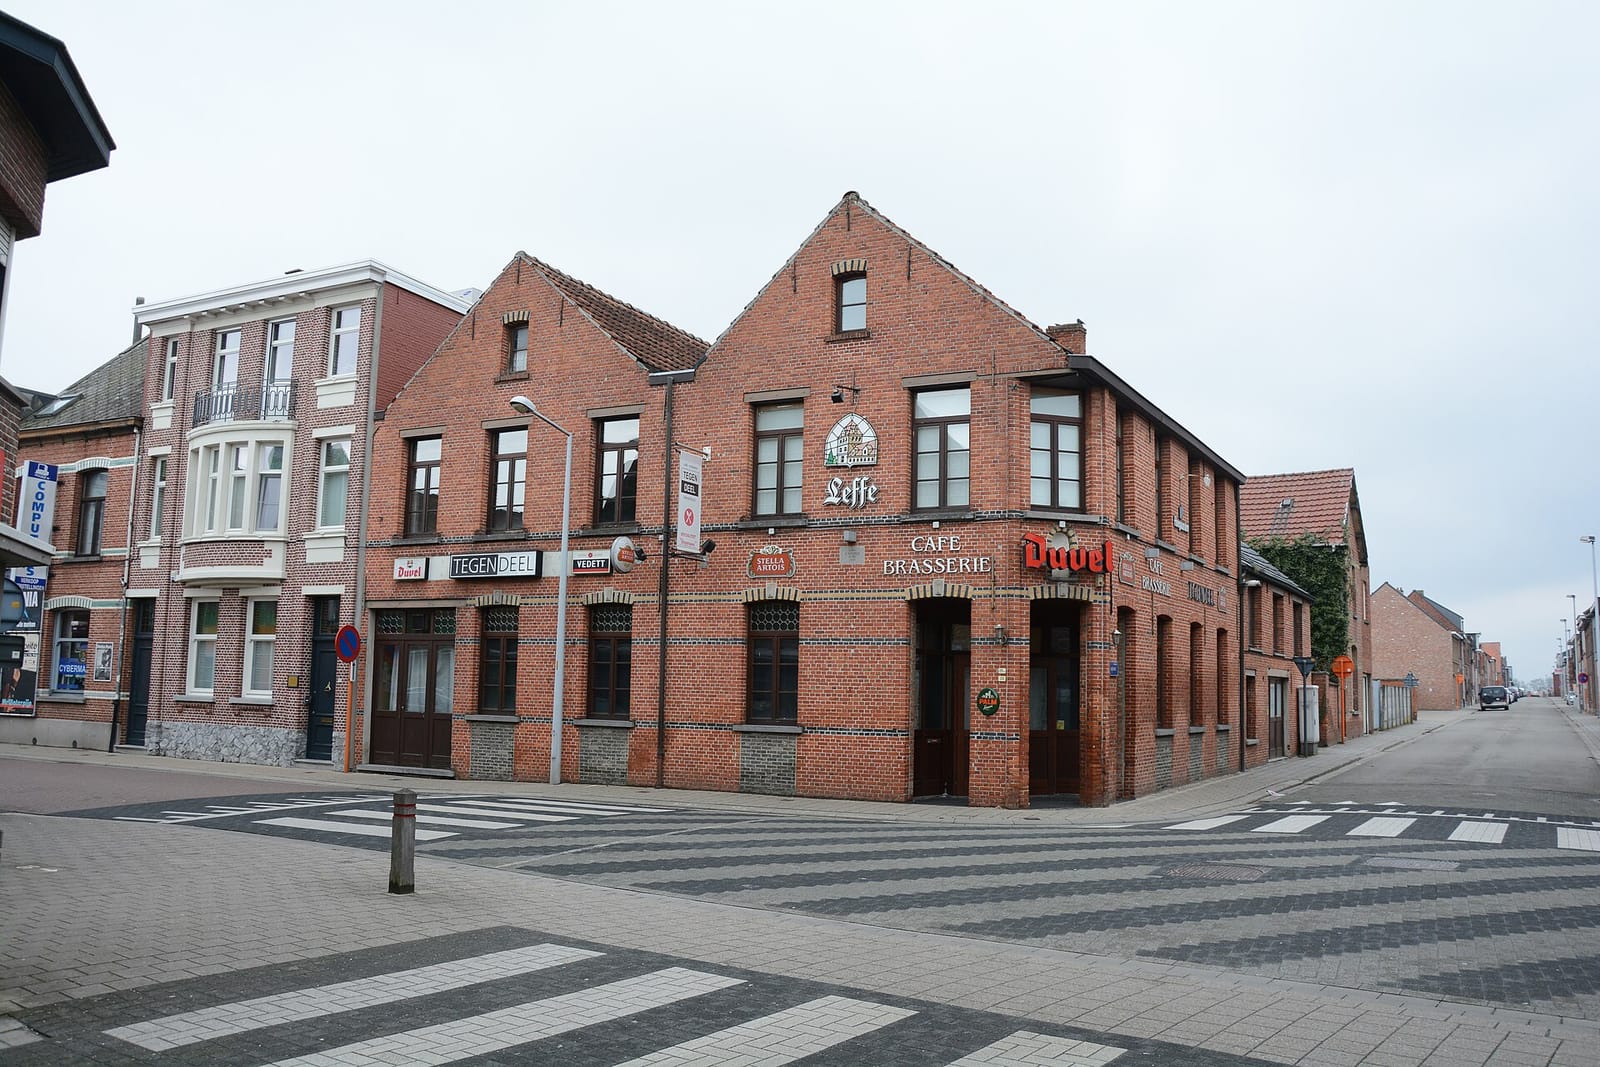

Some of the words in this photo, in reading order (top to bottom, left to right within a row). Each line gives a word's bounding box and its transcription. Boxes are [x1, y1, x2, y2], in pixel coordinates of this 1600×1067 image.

[823, 476, 880, 509] Leffe
[911, 536, 962, 551] CAFE
[1023, 532, 1114, 572] Duvel
[576, 559, 606, 568] VEDETT
[756, 557, 785, 565] STELLA
[883, 557, 992, 575] BRASSERIE
[397, 566, 422, 577] Duvel
[756, 564, 785, 572] ARTOIS
